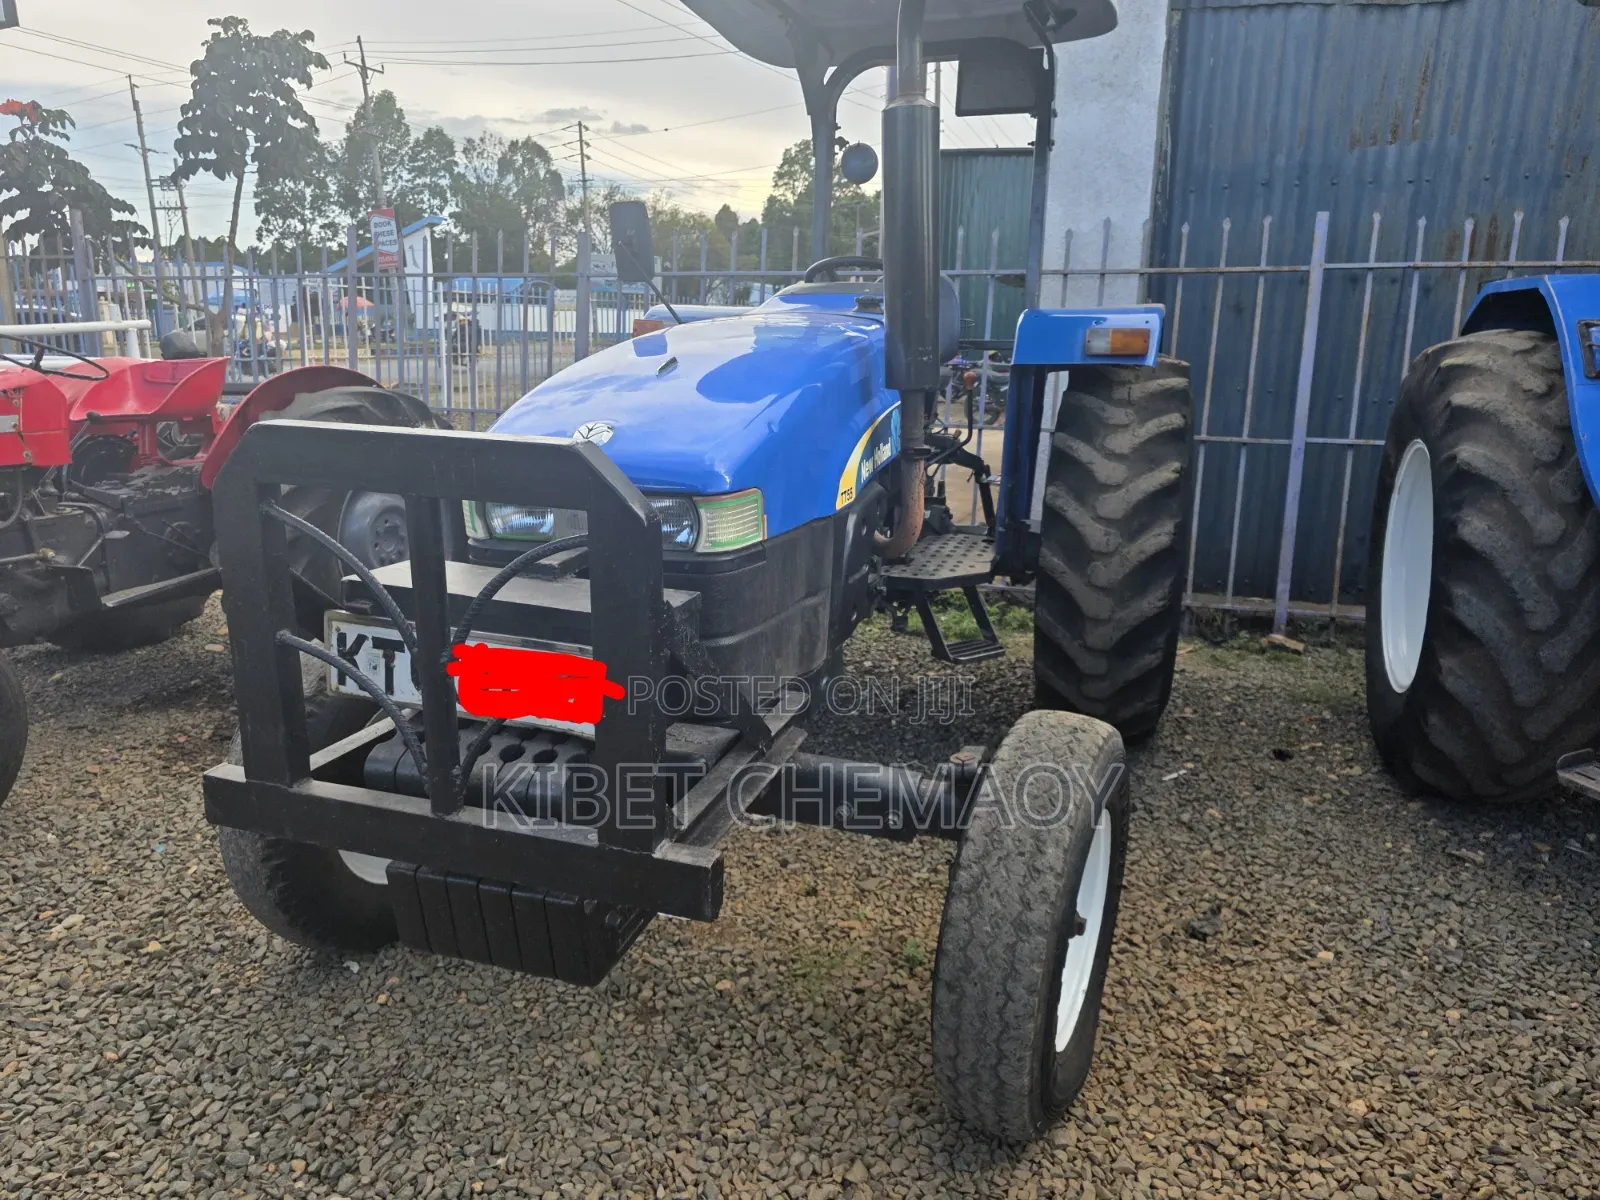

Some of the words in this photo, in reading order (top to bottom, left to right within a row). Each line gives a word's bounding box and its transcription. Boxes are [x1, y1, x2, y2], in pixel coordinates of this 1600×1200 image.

[861, 457, 874, 483] New
[874, 437, 892, 469] Holland
[336, 631, 422, 696] KT
